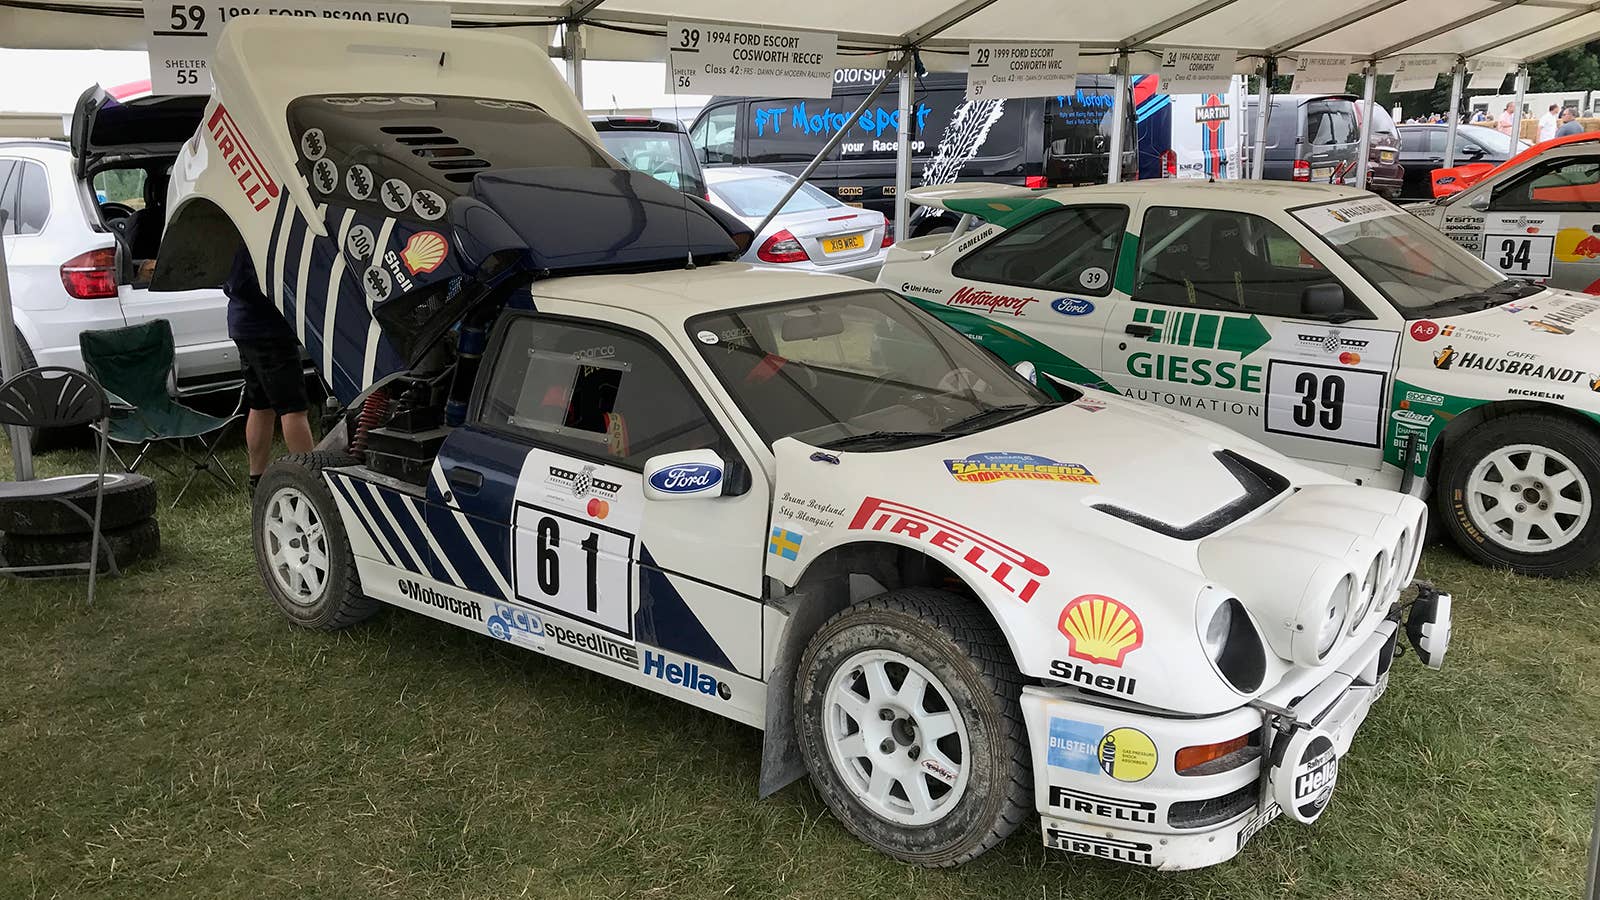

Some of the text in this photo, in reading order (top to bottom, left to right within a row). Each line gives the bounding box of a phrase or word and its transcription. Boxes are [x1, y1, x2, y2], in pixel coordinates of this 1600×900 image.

[171, 5, 206, 30] 59
[377, 12, 410, 24] EVO
[680, 28, 700, 48] 39
[706, 31, 800, 48] 1994 FORD ESCORT
[733, 49, 824, 65] COSWORTH 'RECCE'
[977, 48, 990, 63] 29
[994, 48, 1054, 58] 1999 FORD ESCORT
[1167, 52, 1177, 64] 34
[166, 60, 206, 69] SHELTER
[704, 64, 727, 75] Class
[1010, 60, 1062, 70] COSWORTH WRC
[177, 70, 198, 84] 55
[678, 76, 690, 87] 56
[975, 86, 983, 95] 57
[755, 101, 932, 137] FT Motorspot
[1197, 106, 1229, 122] MARTINI
[842, 142, 864, 155] your
[207, 102, 279, 212] PIRELLI
[844, 237, 858, 248] WRC
[1500, 239, 1531, 271] 34
[384, 250, 414, 293] Shell
[1087, 272, 1101, 284] 39
[922, 286, 942, 295] Motor
[947, 286, 1039, 316] Motorsport
[1057, 299, 1088, 313] Ford
[1415, 326, 1434, 335] A-8
[1126, 352, 1262, 393] GIESSE
[1458, 352, 1586, 384] HAUSBRANDT
[1293, 372, 1345, 431] 39
[1407, 391, 1443, 403] sparco
[1508, 388, 1565, 400] MICHELIN
[1125, 388, 1259, 417] AUTOMATION
[664, 468, 709, 488] Ford
[957, 472, 1099, 484] COMPETITOR 2021
[781, 492, 805, 506] Bruno
[779, 505, 794, 519] Stig
[848, 496, 1051, 604] PIRELLI
[537, 517, 599, 613] 61
[408, 582, 483, 622] Motorcraft
[497, 605, 544, 634] CCD
[545, 621, 630, 662] speedline
[643, 650, 717, 697] Hella
[1049, 659, 1137, 695] Shell
[1050, 736, 1099, 756] BILSTEIN
[1299, 760, 1336, 797] Hella
[1049, 785, 1157, 825] PIRELLI
